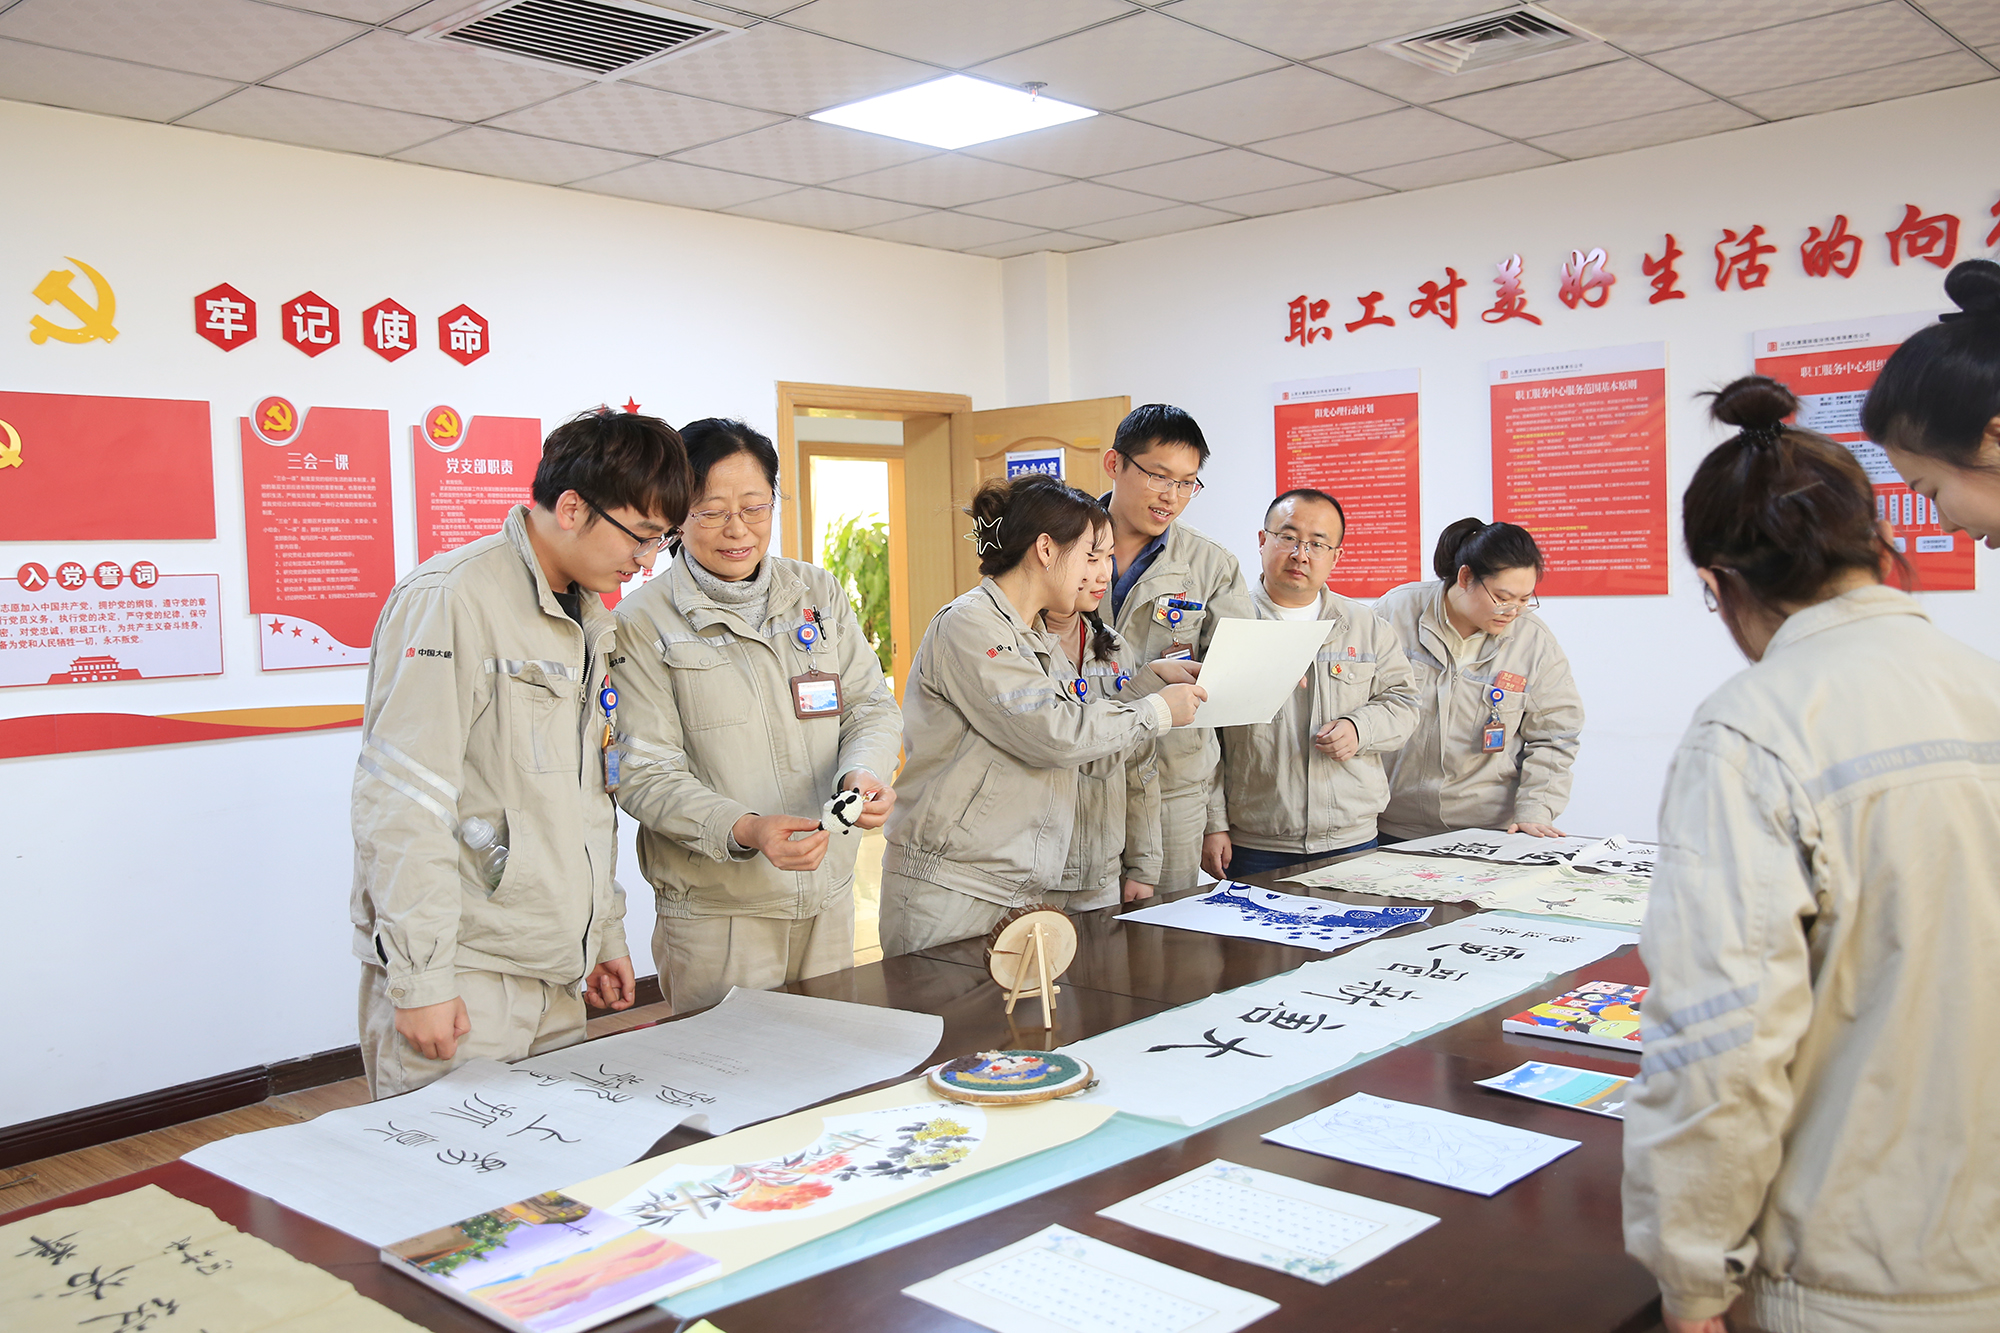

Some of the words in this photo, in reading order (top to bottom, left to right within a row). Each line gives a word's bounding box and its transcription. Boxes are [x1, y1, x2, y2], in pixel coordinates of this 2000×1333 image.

[1283, 194, 2000, 347] 职工对美好生活的向
[205, 297, 482, 355] 牢记使命
[1515, 379, 1638, 401] 职工服务中心服务范围基本原则
[1314, 403, 1375, 419] 阳光心理行动计划
[287, 452, 350, 471] 三会一课
[446, 457, 514, 475] 党支部职责
[24, 565, 156, 588] 入党誓词
[1853, 748, 1920, 776] CHINA
